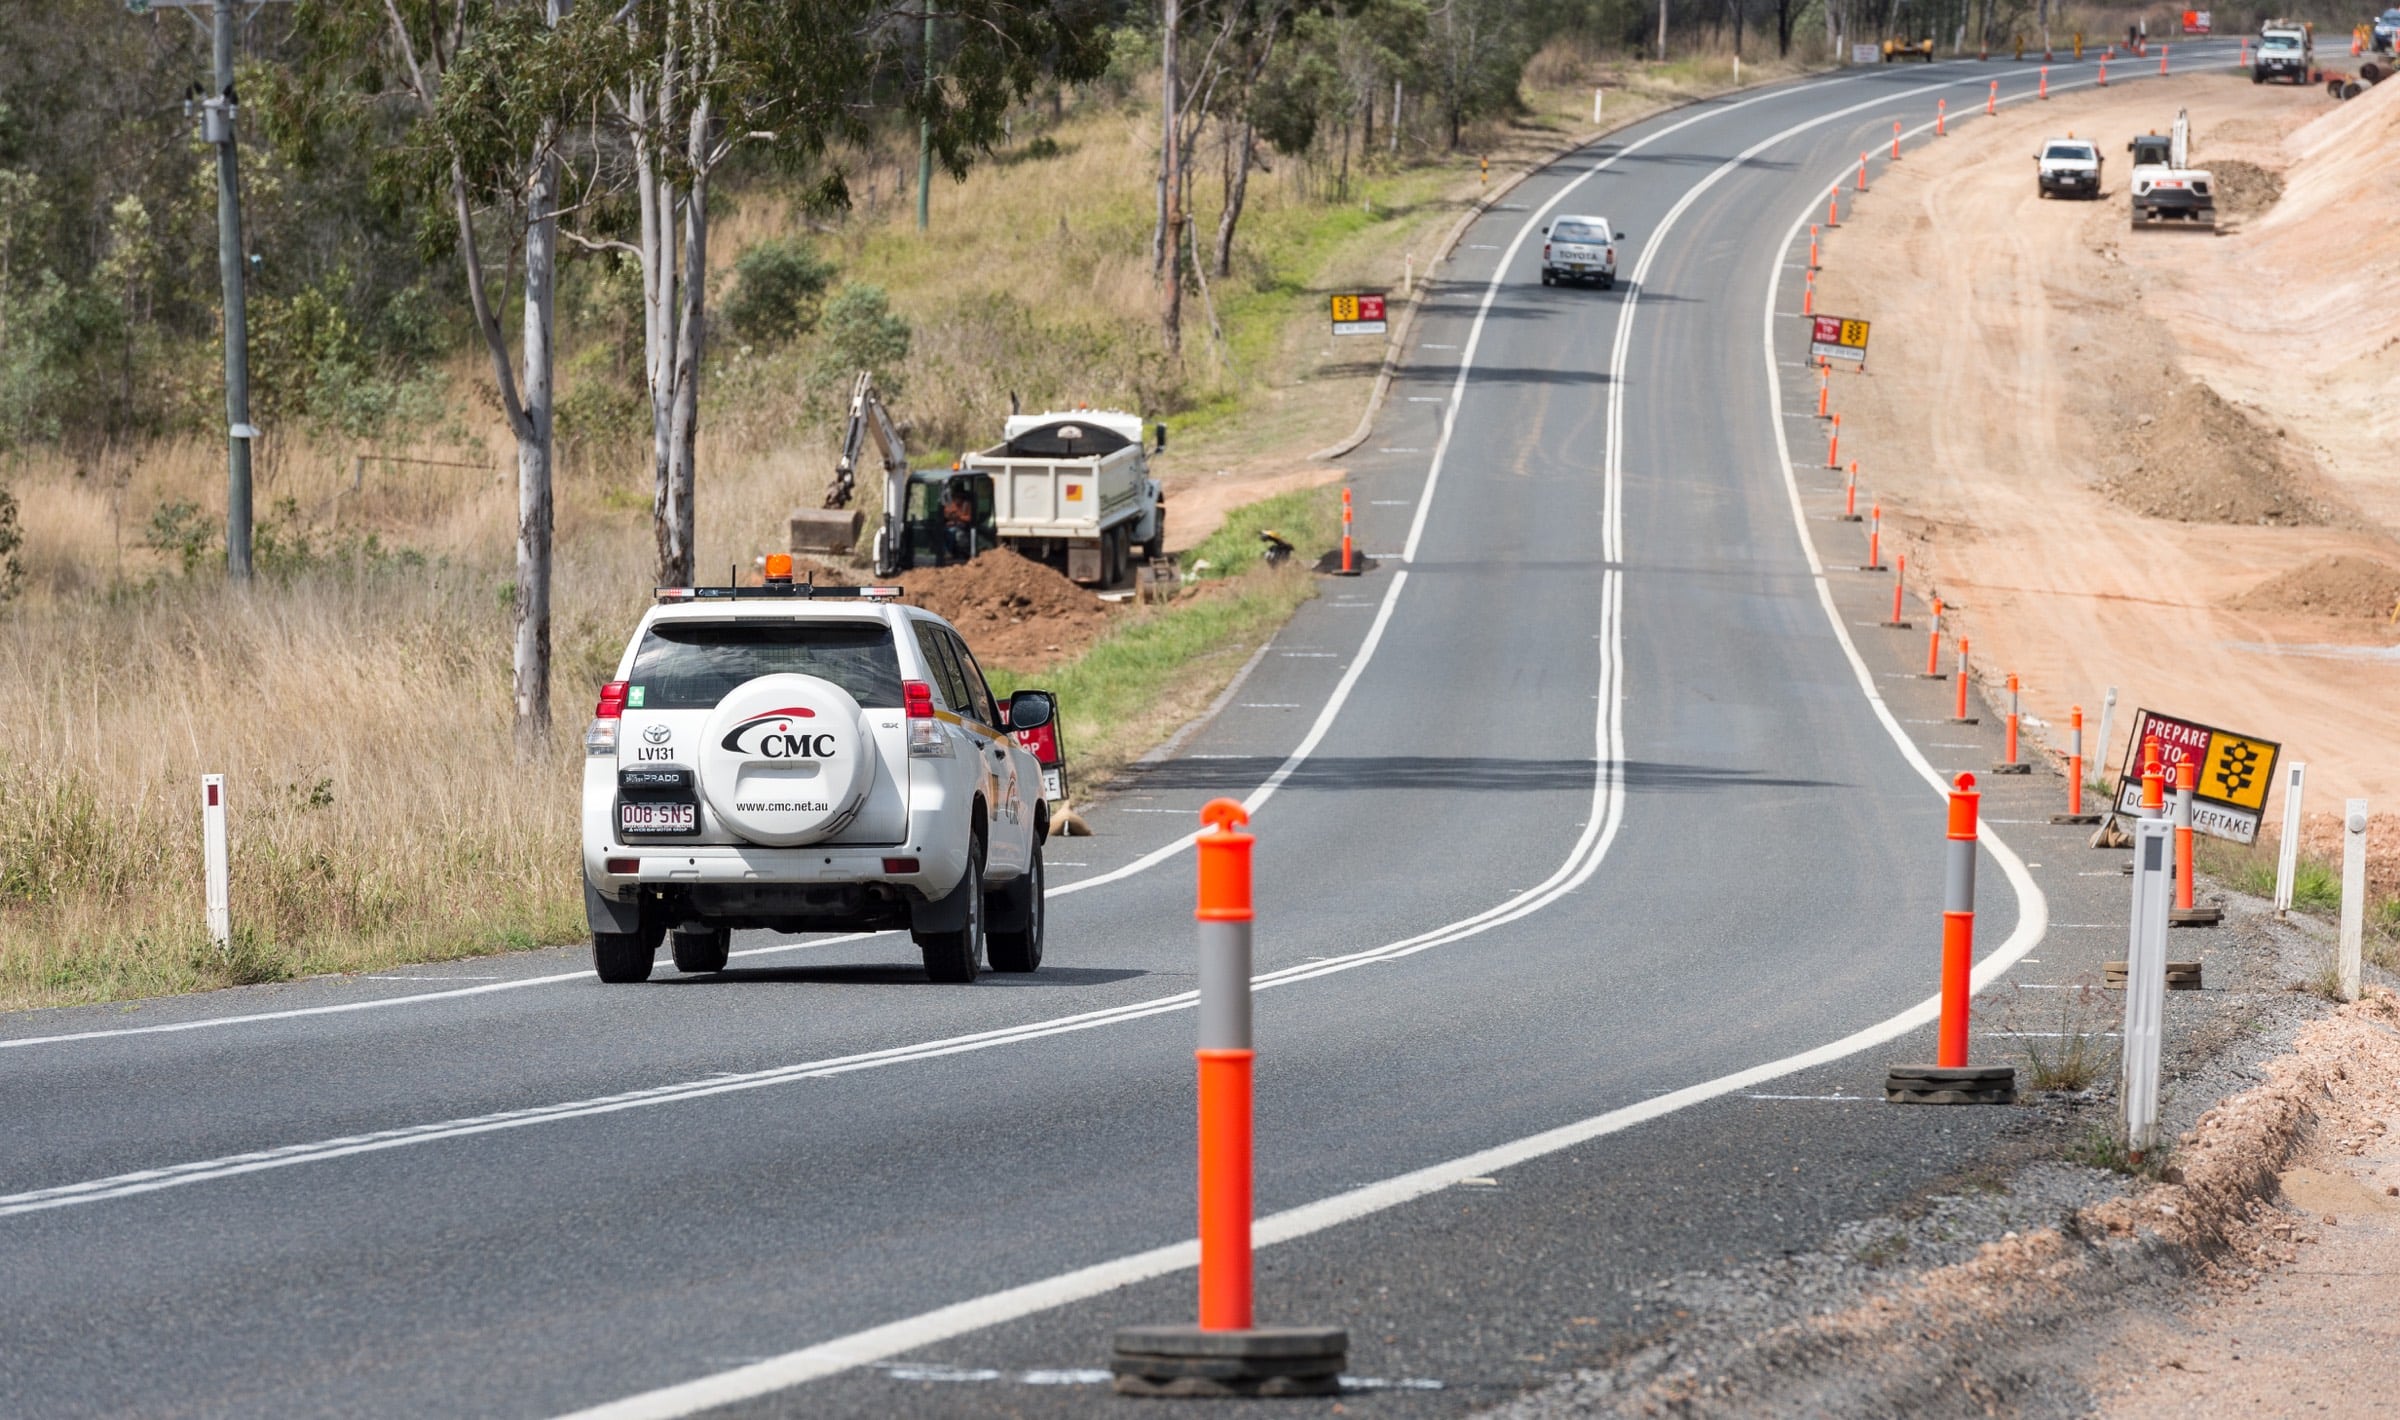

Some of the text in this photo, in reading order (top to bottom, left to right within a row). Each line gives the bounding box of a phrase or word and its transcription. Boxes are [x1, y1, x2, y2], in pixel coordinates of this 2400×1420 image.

[1560, 250, 1598, 261] TOYOTA
[2146, 718, 2208, 748] PREPARE
[638, 747, 674, 760] LV131
[760, 734, 836, 758] CMC
[2163, 743, 2182, 763] TO
[643, 774, 679, 782] PRADO
[736, 801, 829, 812] www.cmc.net.au
[2192, 807, 2252, 835] VERTAKE
